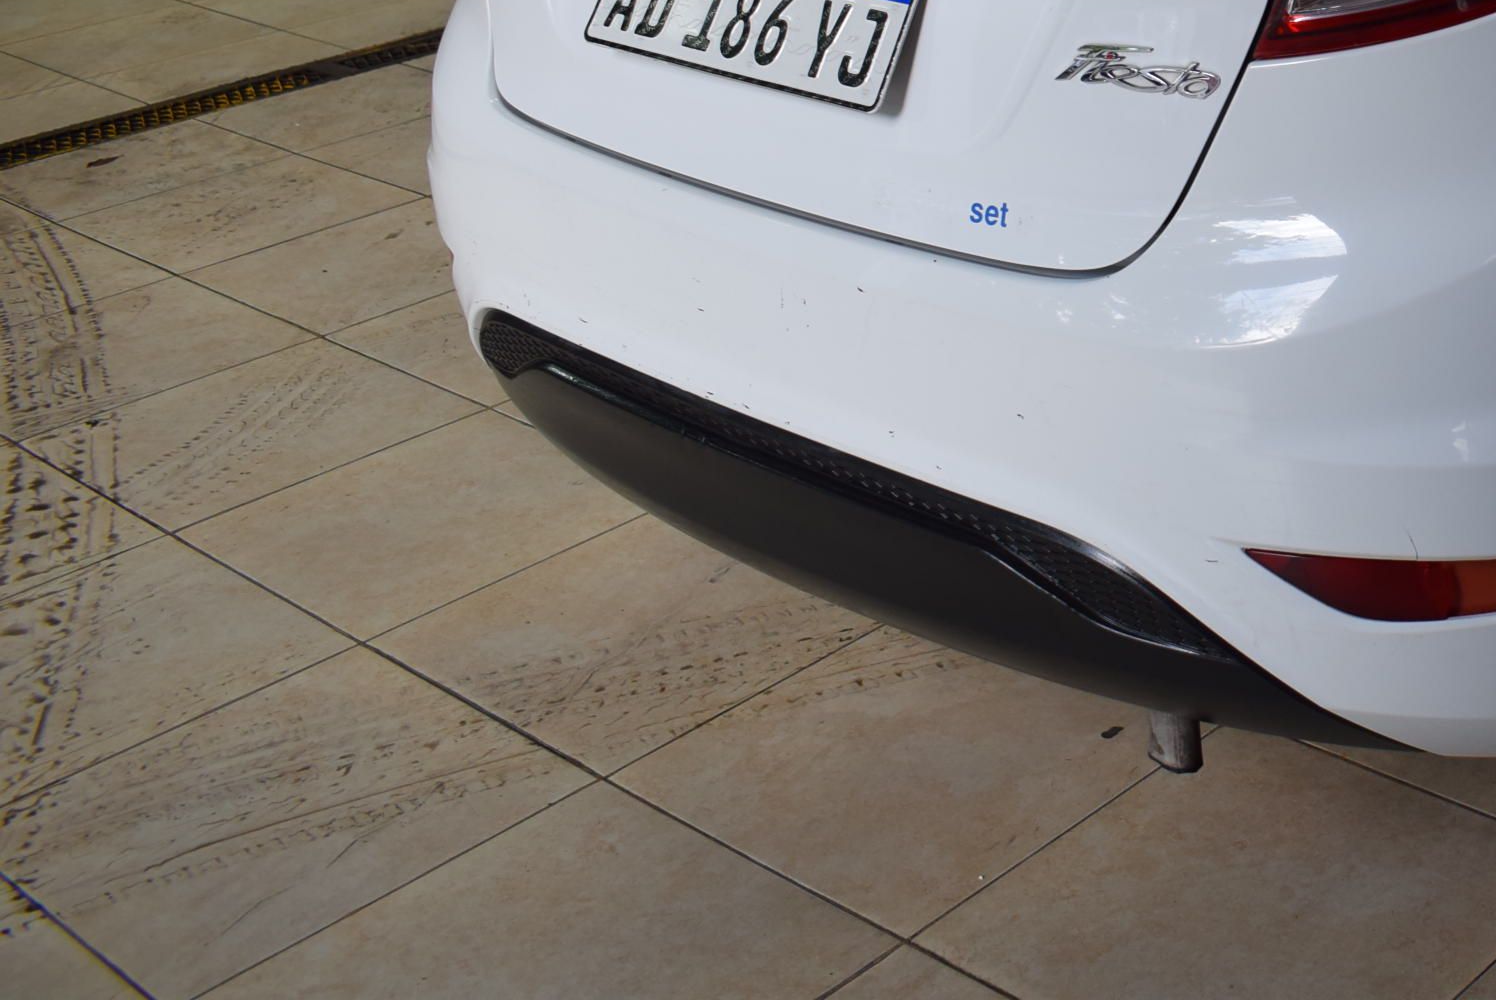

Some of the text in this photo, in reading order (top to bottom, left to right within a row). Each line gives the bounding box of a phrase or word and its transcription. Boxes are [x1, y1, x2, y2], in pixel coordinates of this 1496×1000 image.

[807, 0, 889, 88] YJ
[1054, 43, 1222, 100] Fiesta
[969, 202, 1010, 228] set
